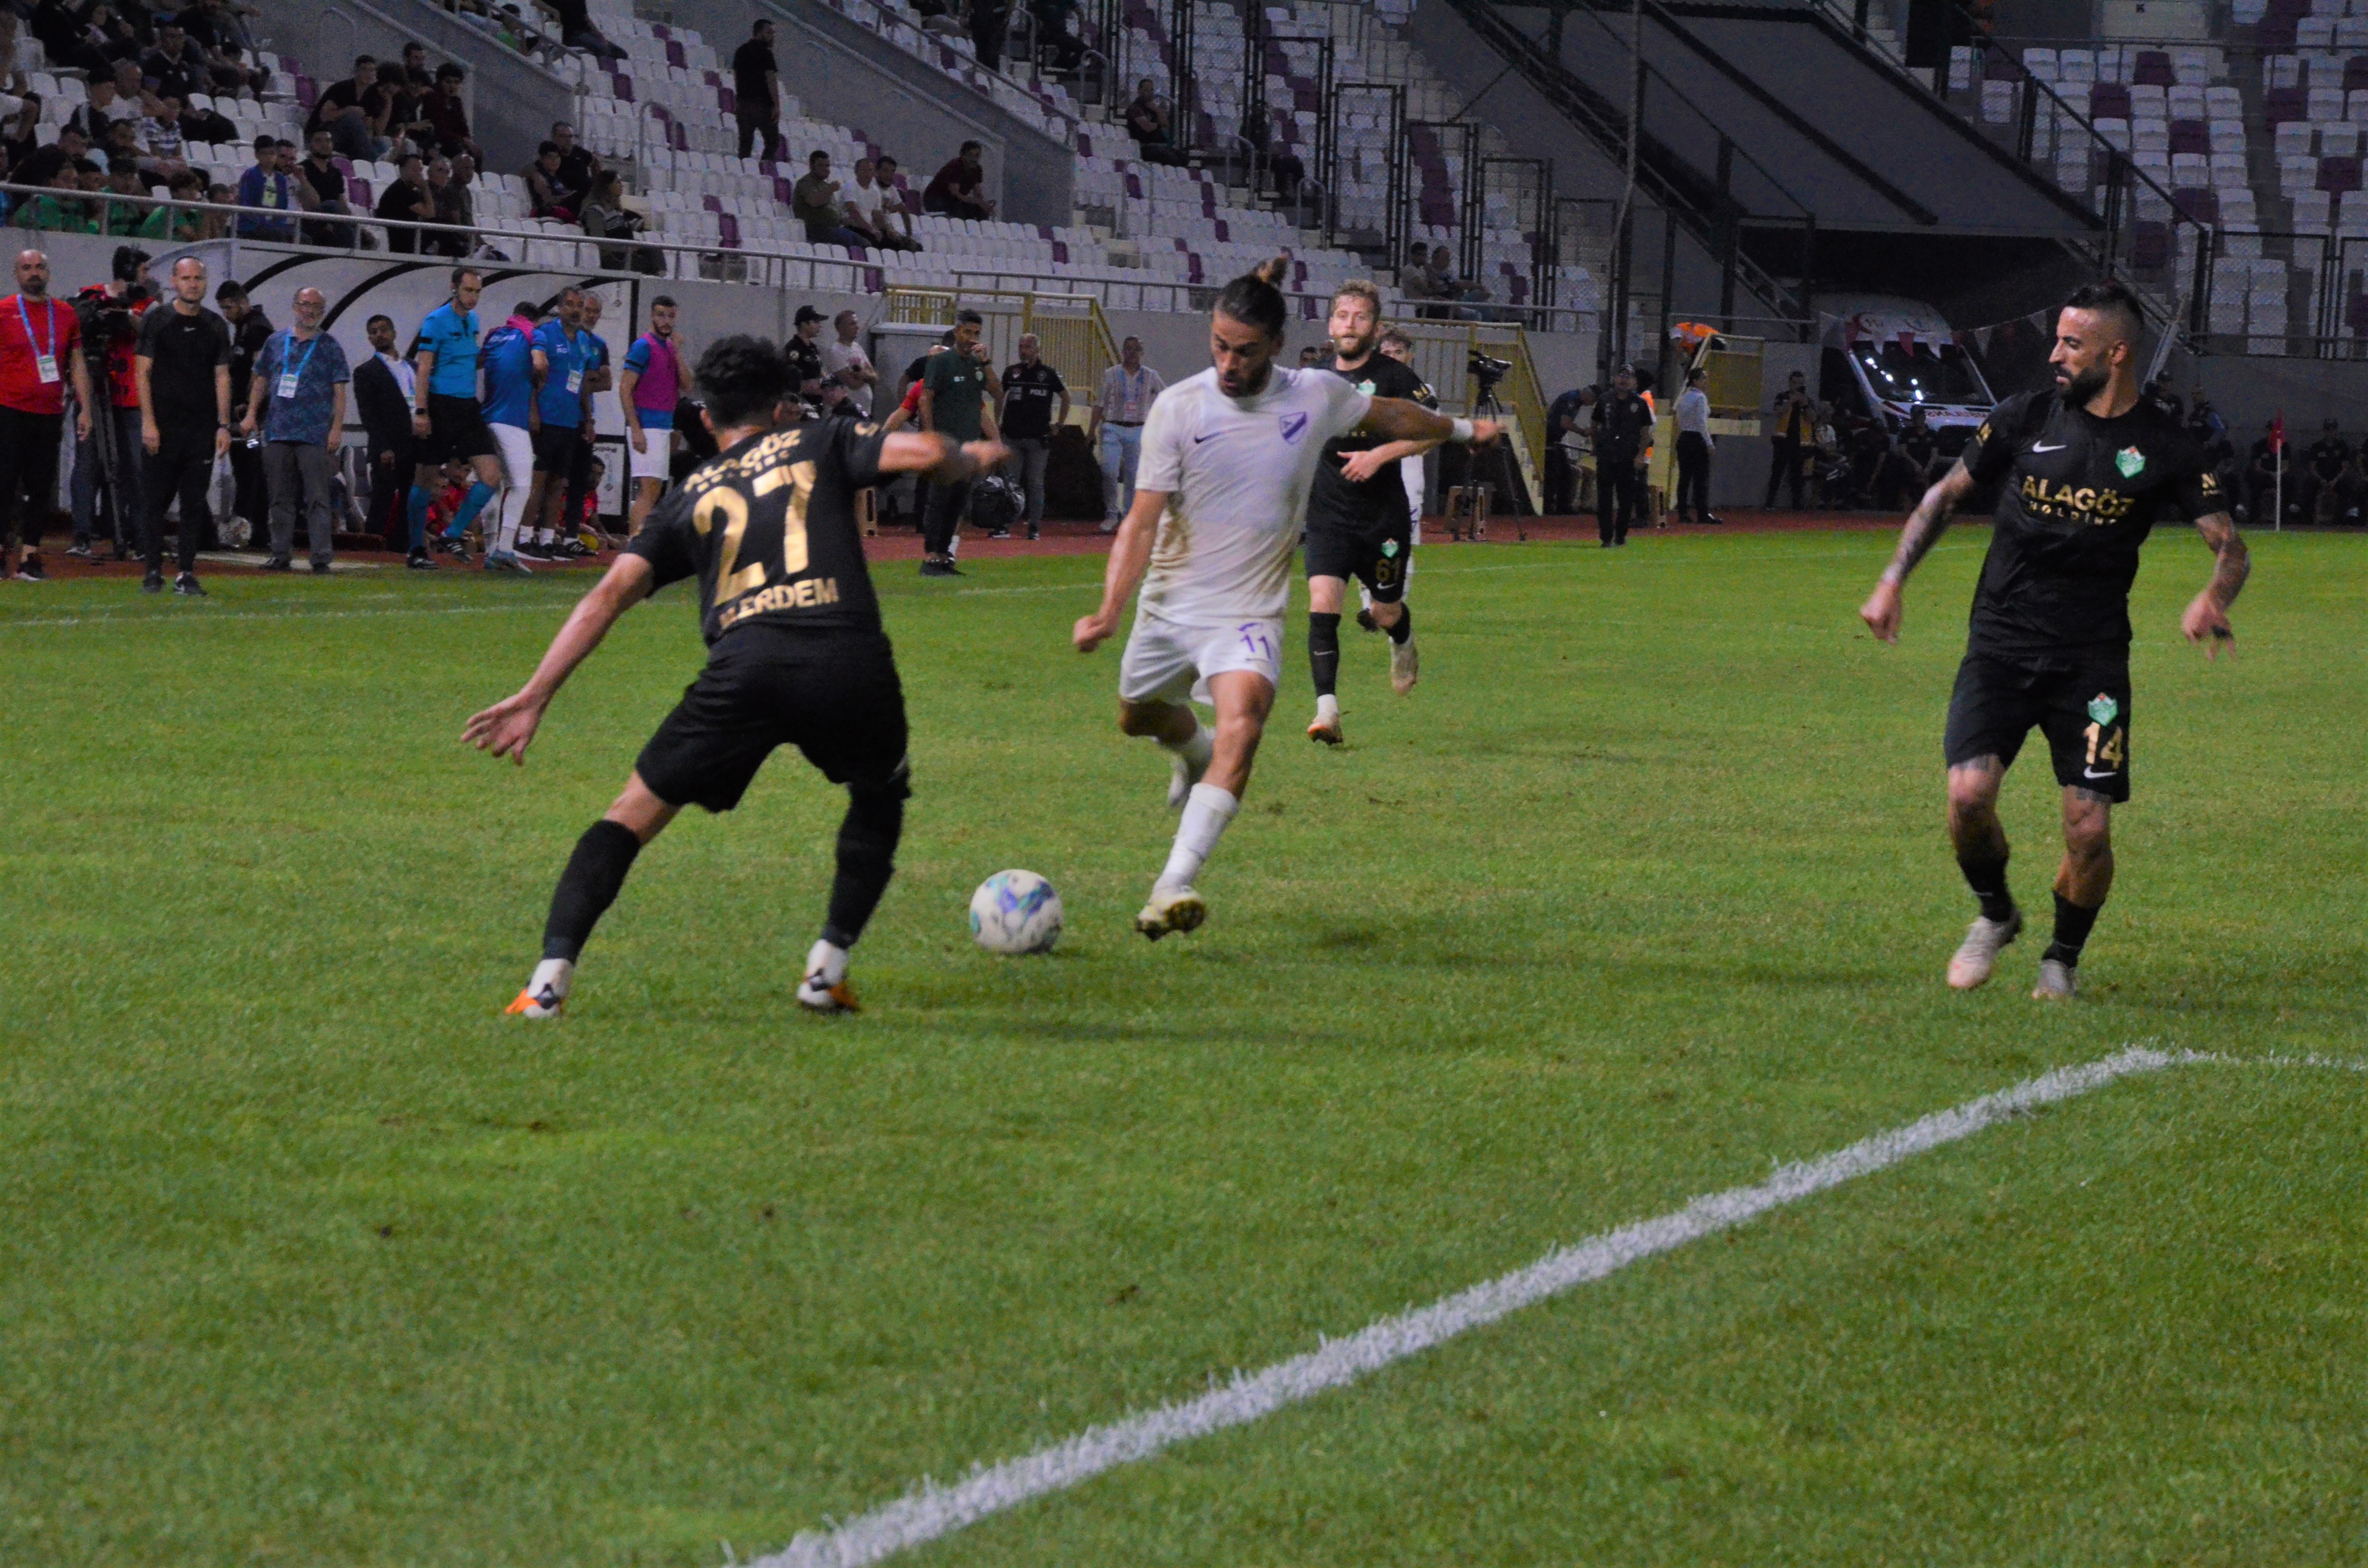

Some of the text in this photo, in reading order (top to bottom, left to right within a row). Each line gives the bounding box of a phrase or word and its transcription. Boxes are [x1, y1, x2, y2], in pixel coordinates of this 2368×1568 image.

[2022, 475, 2136, 516] ALAGÖZ
[692, 460, 816, 607] 27
[1376, 558, 1402, 583] 61
[1240, 635, 1272, 660] 11
[2083, 721, 2123, 770] 14
